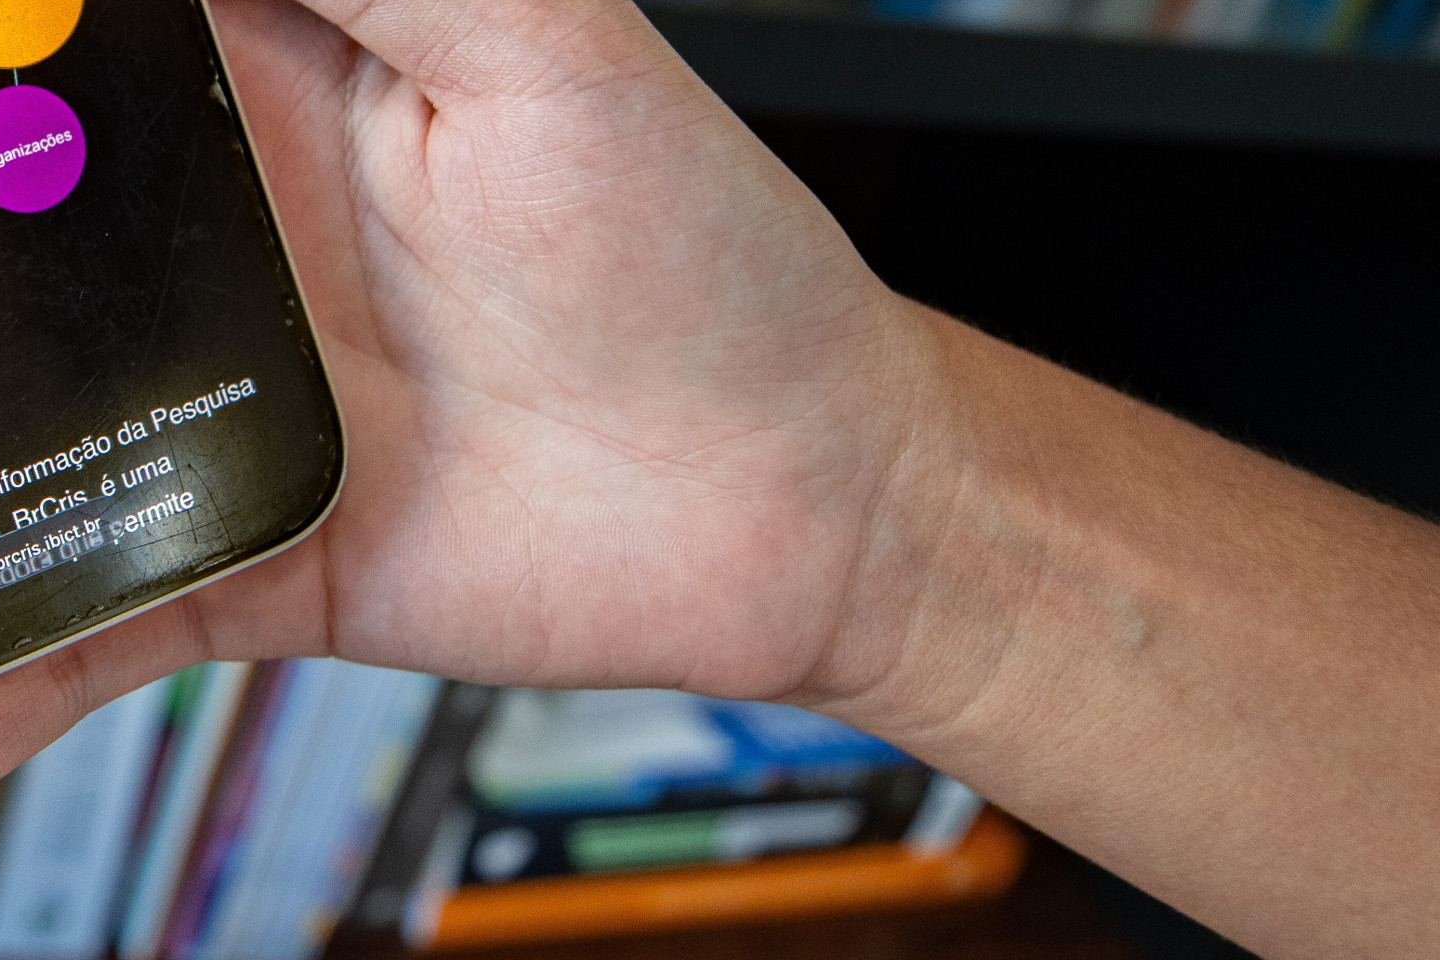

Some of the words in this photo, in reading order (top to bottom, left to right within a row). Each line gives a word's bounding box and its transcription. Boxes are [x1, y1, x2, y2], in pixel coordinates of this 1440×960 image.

[116, 419, 149, 445] da
[150, 377, 258, 432] Pesquisa
[12, 490, 88, 530] BrCris
[102, 474, 116, 497] é
[121, 456, 174, 488] uma
